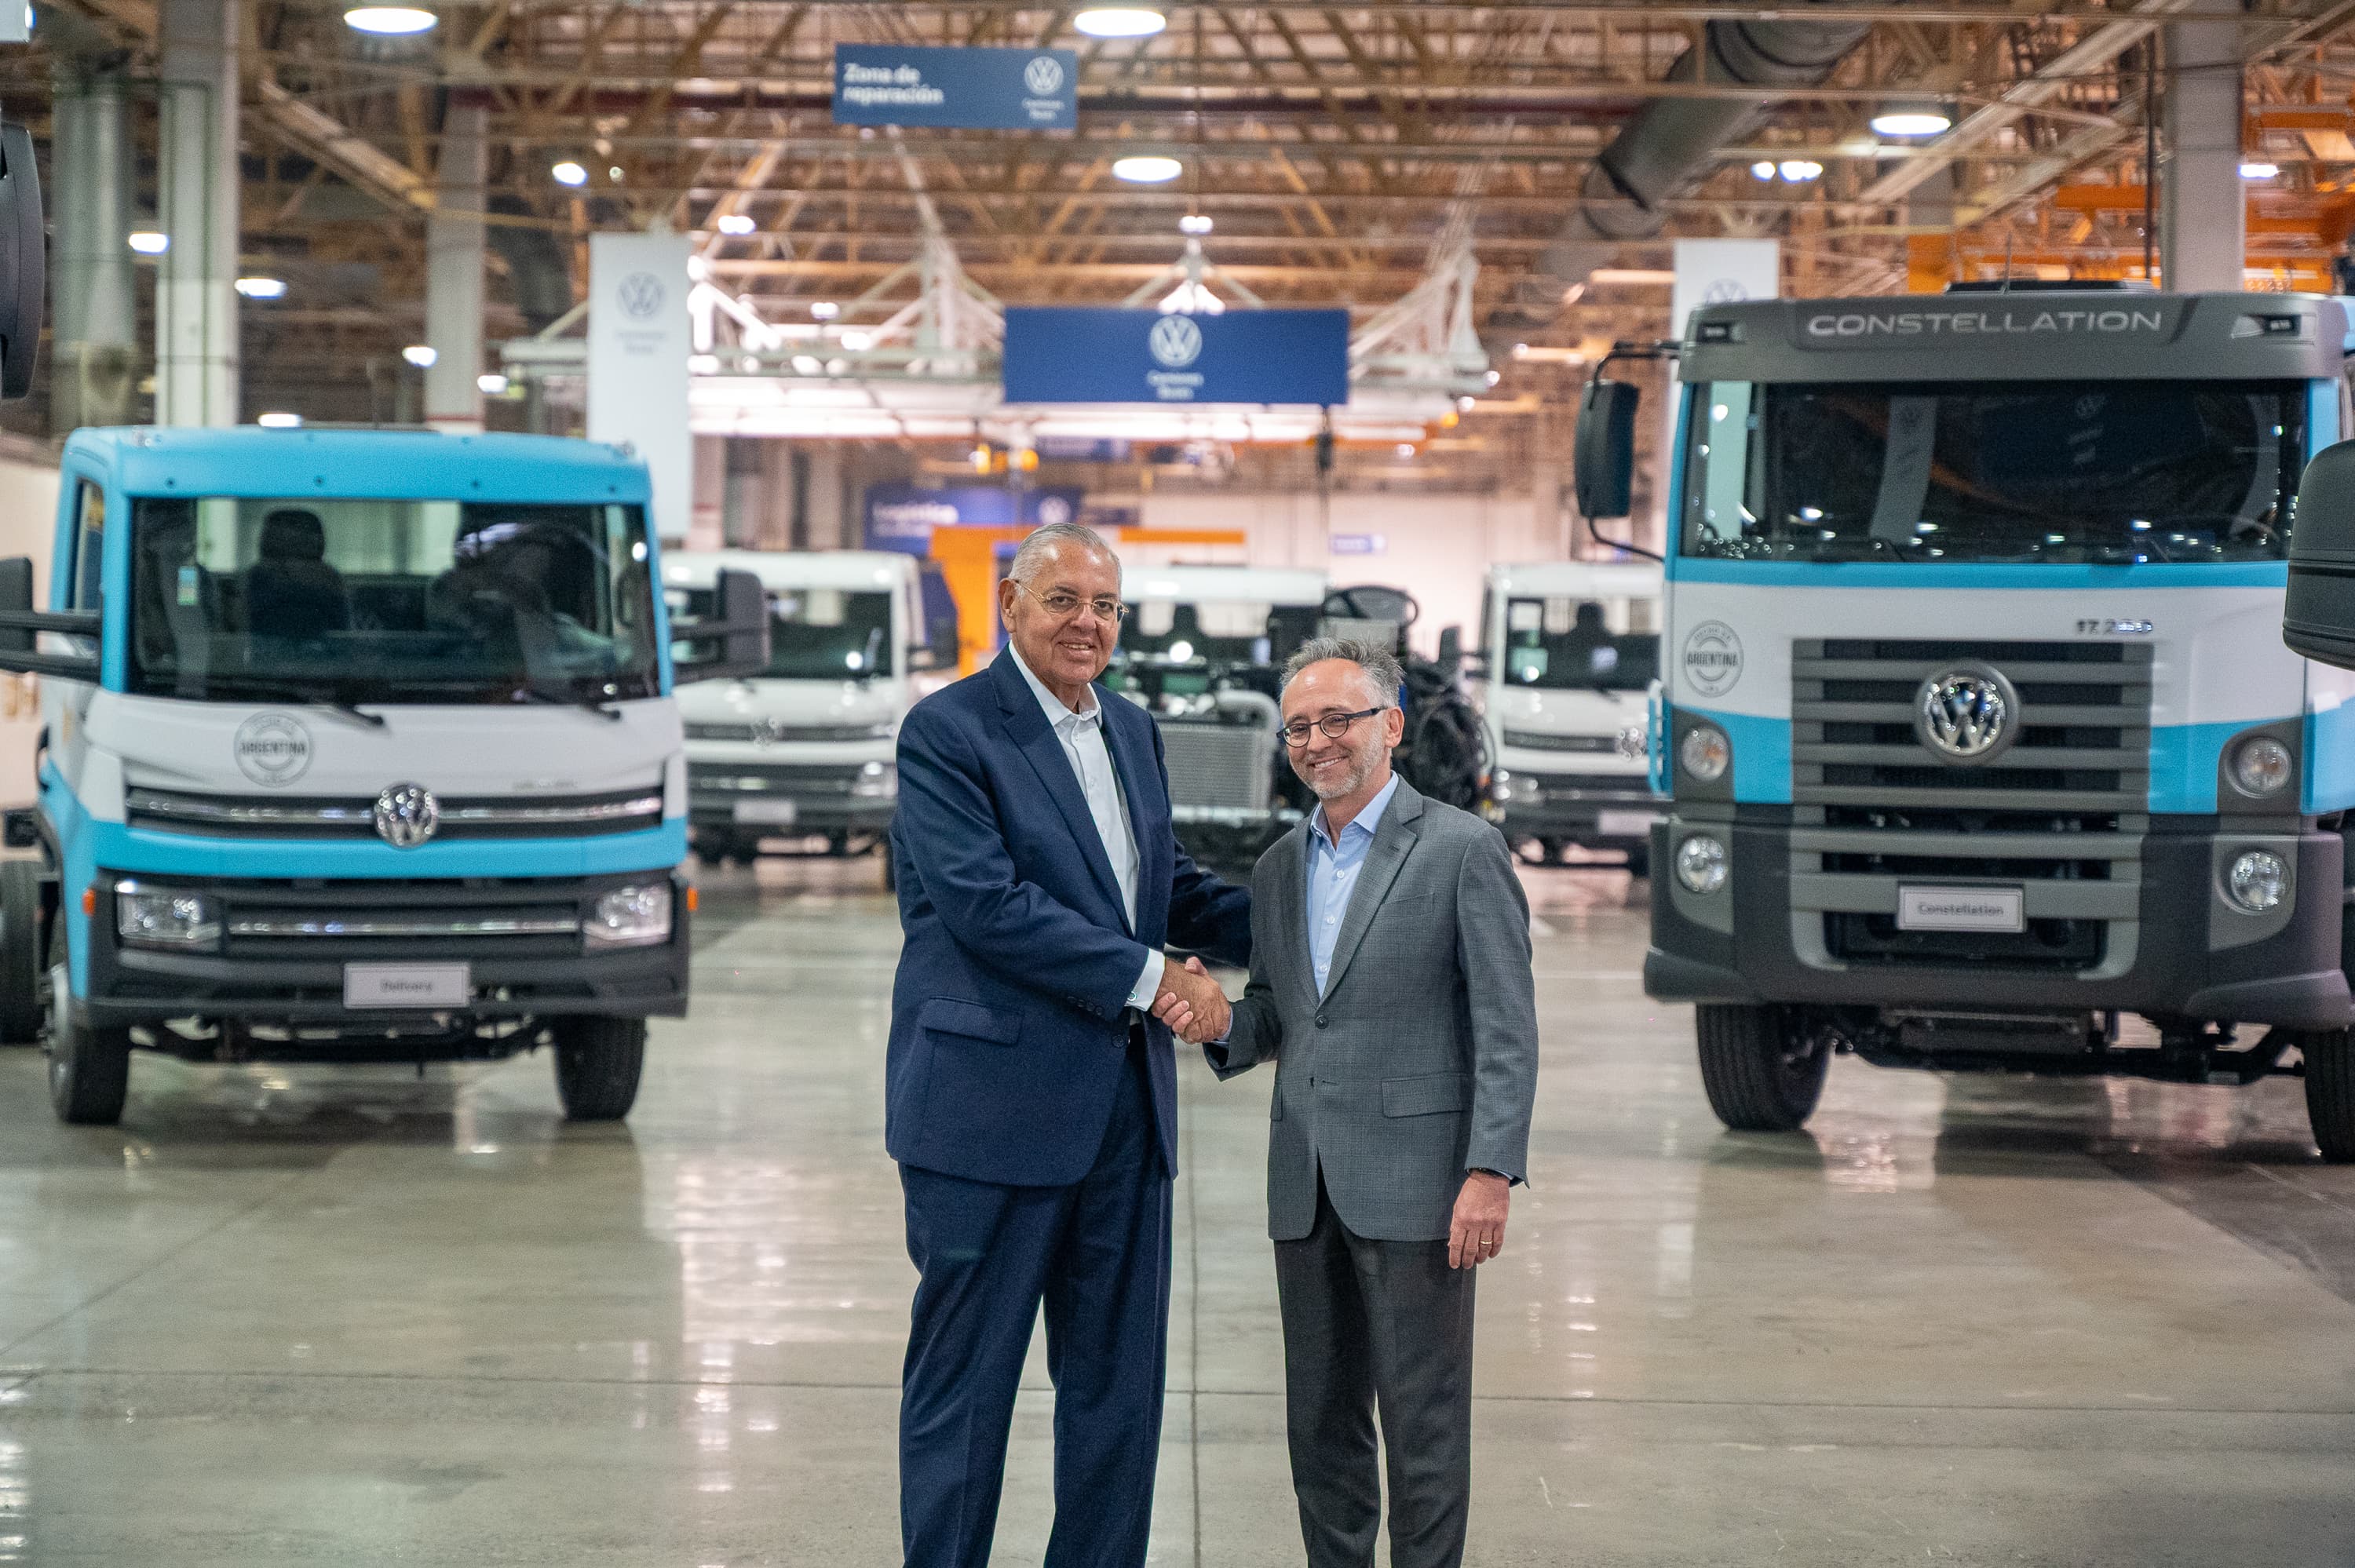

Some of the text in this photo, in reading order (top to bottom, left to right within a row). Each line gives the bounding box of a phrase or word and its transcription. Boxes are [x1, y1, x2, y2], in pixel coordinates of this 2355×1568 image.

[843, 63, 921, 84] Zona de
[842, 83, 944, 106] reparación
[1807, 310, 2161, 337] CONSTELLATION
[1686, 651, 1738, 667] ARGENTINA
[239, 740, 306, 756] ARGENTINA
[1919, 902, 2005, 917] Constellation
